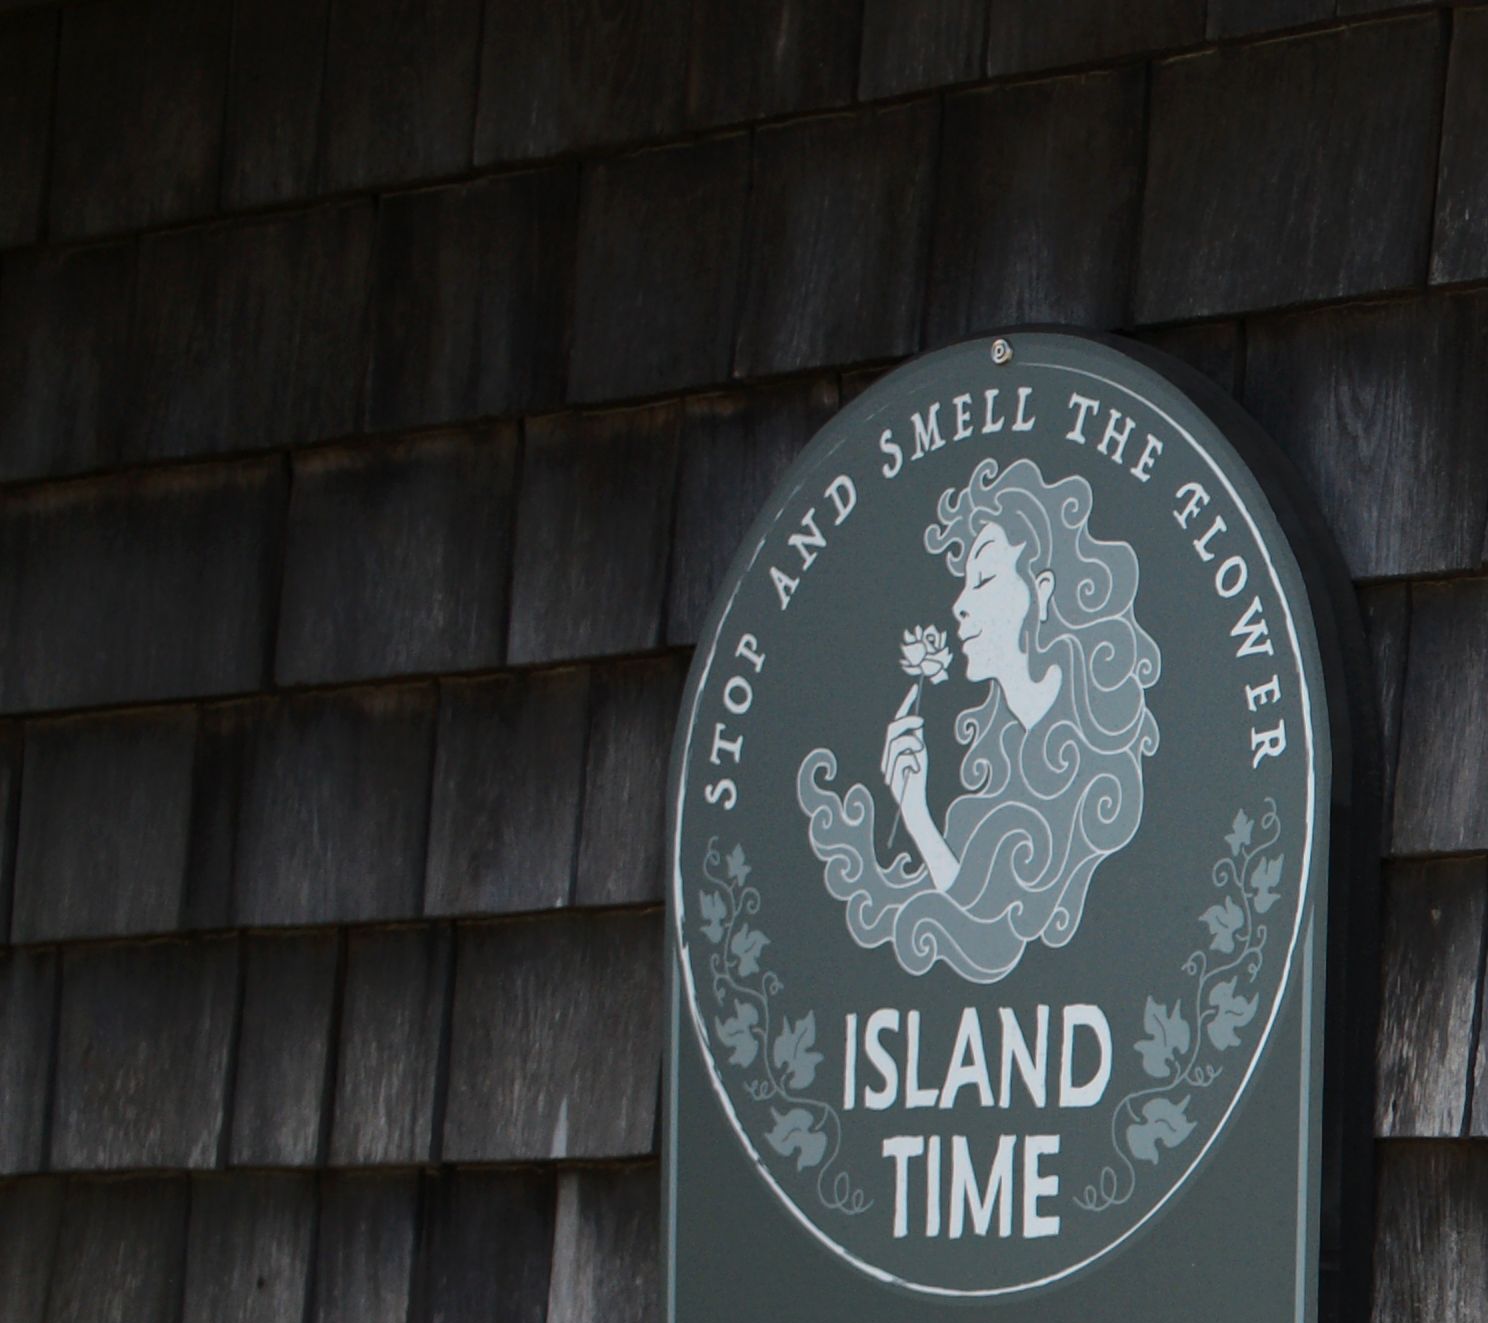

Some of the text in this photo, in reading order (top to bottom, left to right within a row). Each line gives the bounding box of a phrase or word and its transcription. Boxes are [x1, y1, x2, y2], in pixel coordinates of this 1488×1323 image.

[705, 386, 1288, 810] STOP AND SMELL THE FLOWER
[843, 1003, 1113, 1111] ISLAND
[882, 1134, 1061, 1240] TIME
